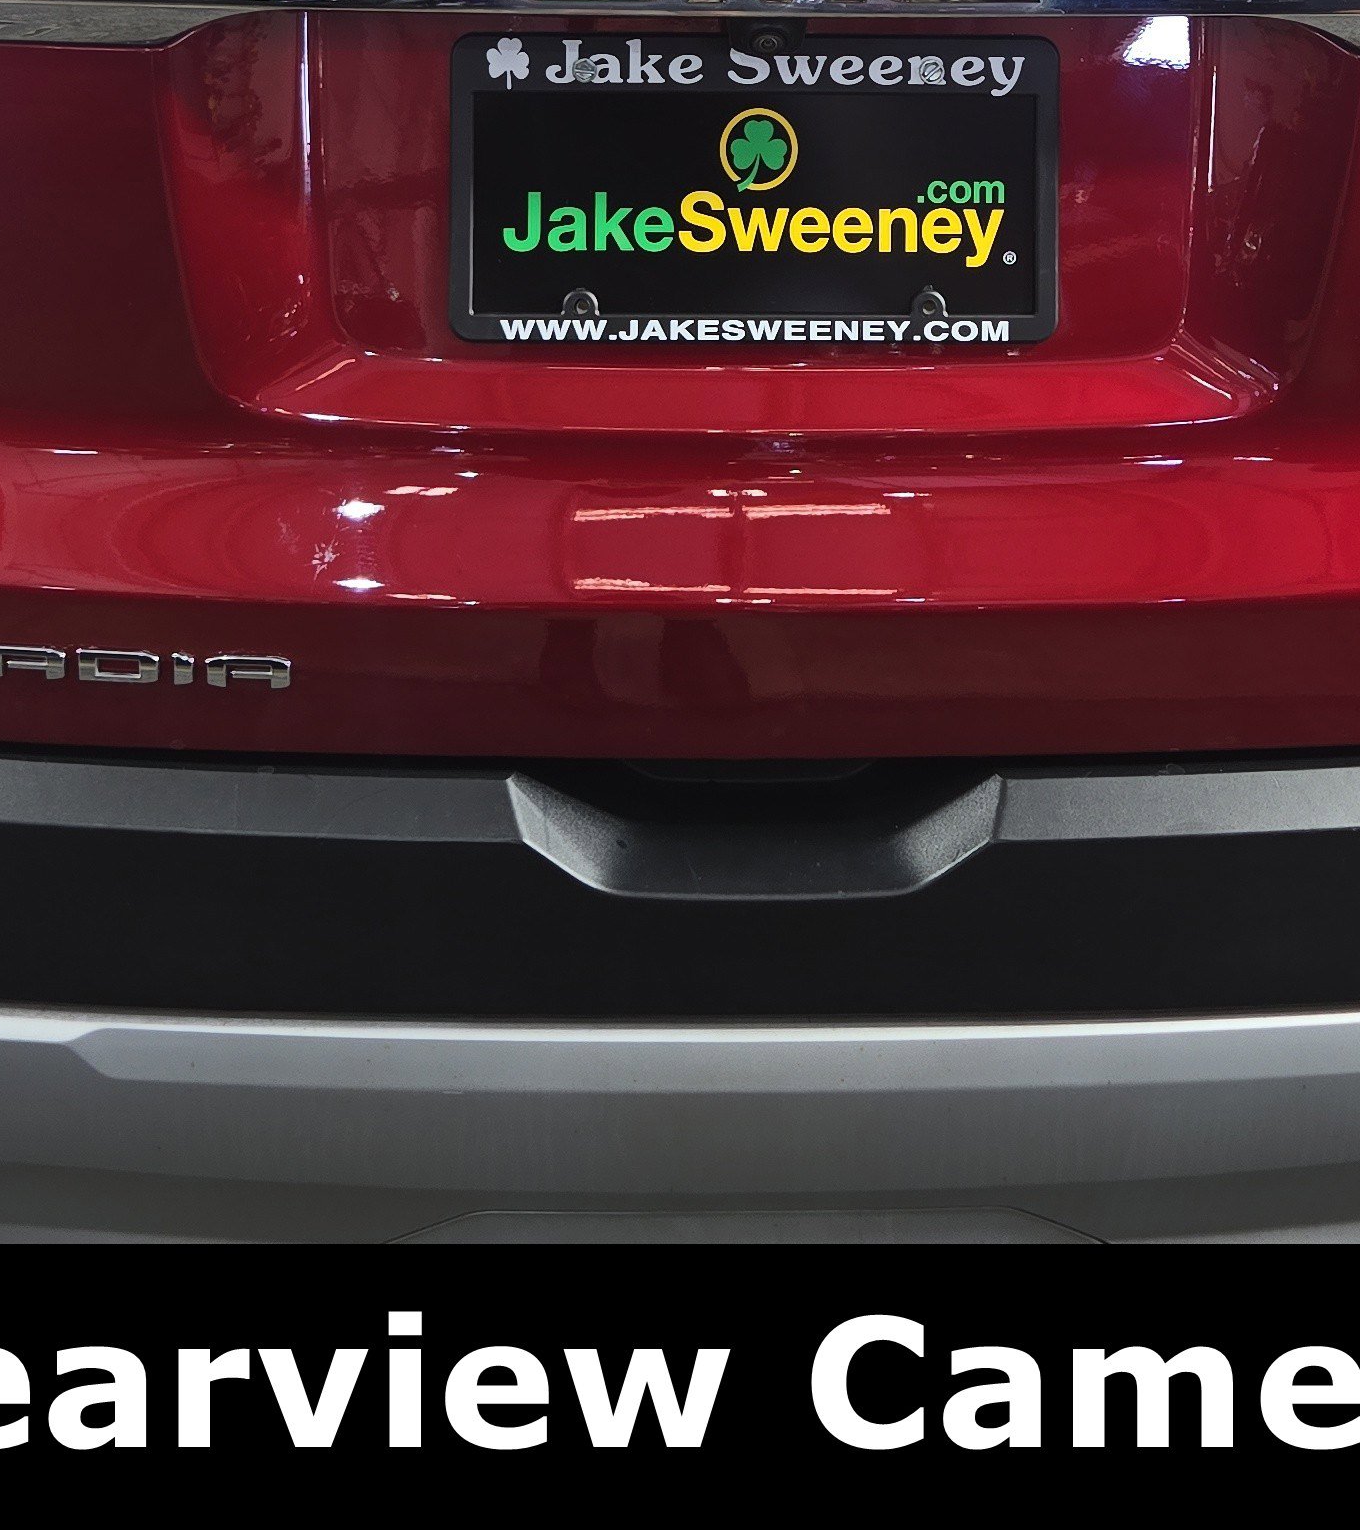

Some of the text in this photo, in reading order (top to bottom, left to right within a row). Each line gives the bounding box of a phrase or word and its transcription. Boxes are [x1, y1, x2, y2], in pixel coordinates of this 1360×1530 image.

[545, 39, 1026, 97] Jake Sweeney
[916, 179, 1005, 205] .com
[499, 319, 1010, 343] WWW.JAKESWEENEY.COM
